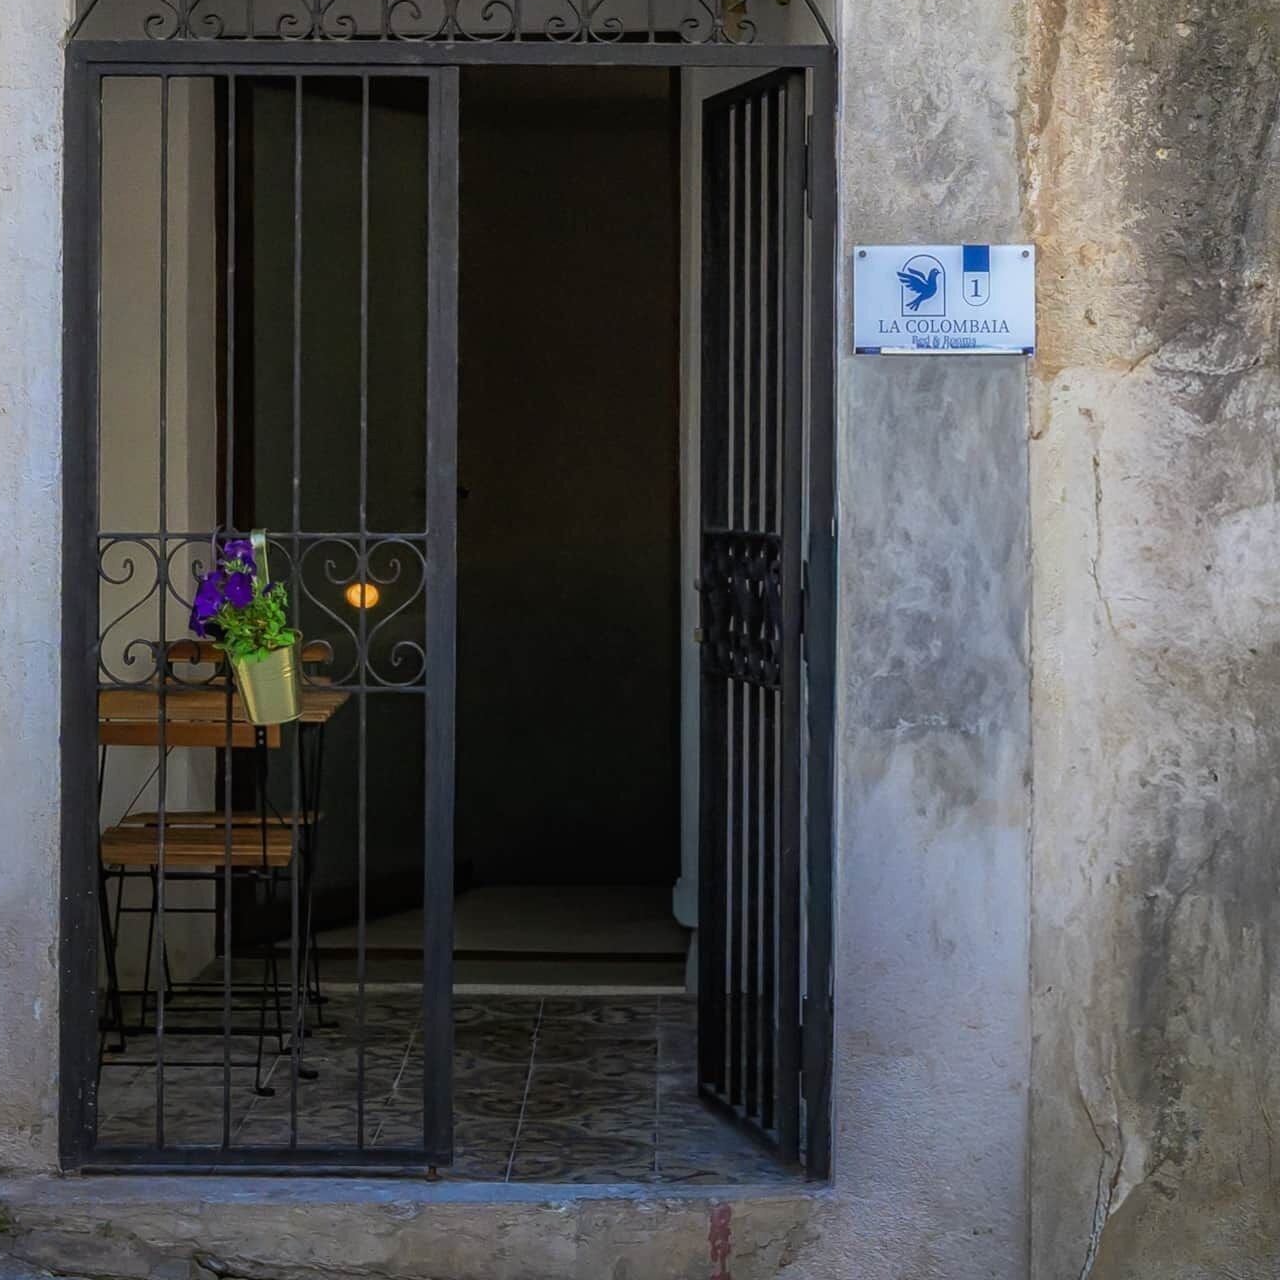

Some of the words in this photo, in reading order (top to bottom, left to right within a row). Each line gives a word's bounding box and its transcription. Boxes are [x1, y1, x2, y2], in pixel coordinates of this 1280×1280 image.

[970, 279, 982, 298] 1
[878, 319, 900, 333] LA
[905, 319, 1010, 333] COLOMBAIA
